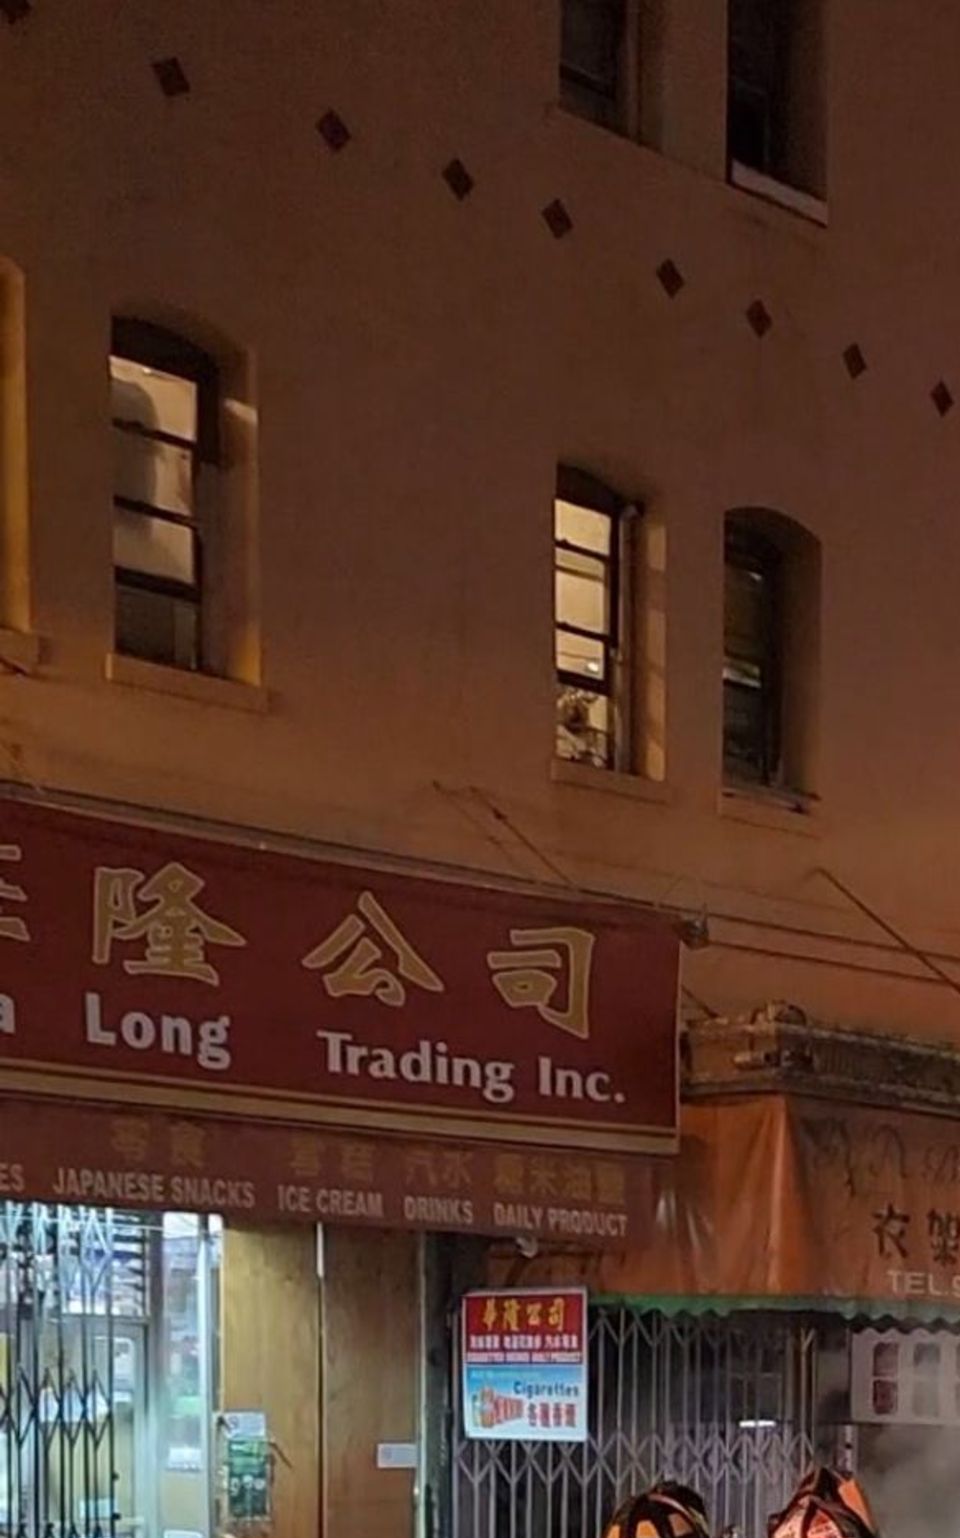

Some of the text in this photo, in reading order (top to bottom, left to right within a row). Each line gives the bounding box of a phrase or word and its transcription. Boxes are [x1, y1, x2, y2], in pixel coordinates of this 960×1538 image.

[84, 991, 232, 1071] Long
[316, 1028, 516, 1104] Trading
[538, 1055, 626, 1104] Inc.
[53, 1166, 164, 1202] JAPANESE
[170, 1175, 256, 1209] SNACKS
[277, 1184, 311, 1213] ICE
[316, 1187, 385, 1219] CREAM
[403, 1195, 474, 1226] DRINKS
[493, 1202, 547, 1231] DAILY
[547, 1207, 628, 1237] PRODUCT
[513, 1380, 580, 1400] Cigarettes
